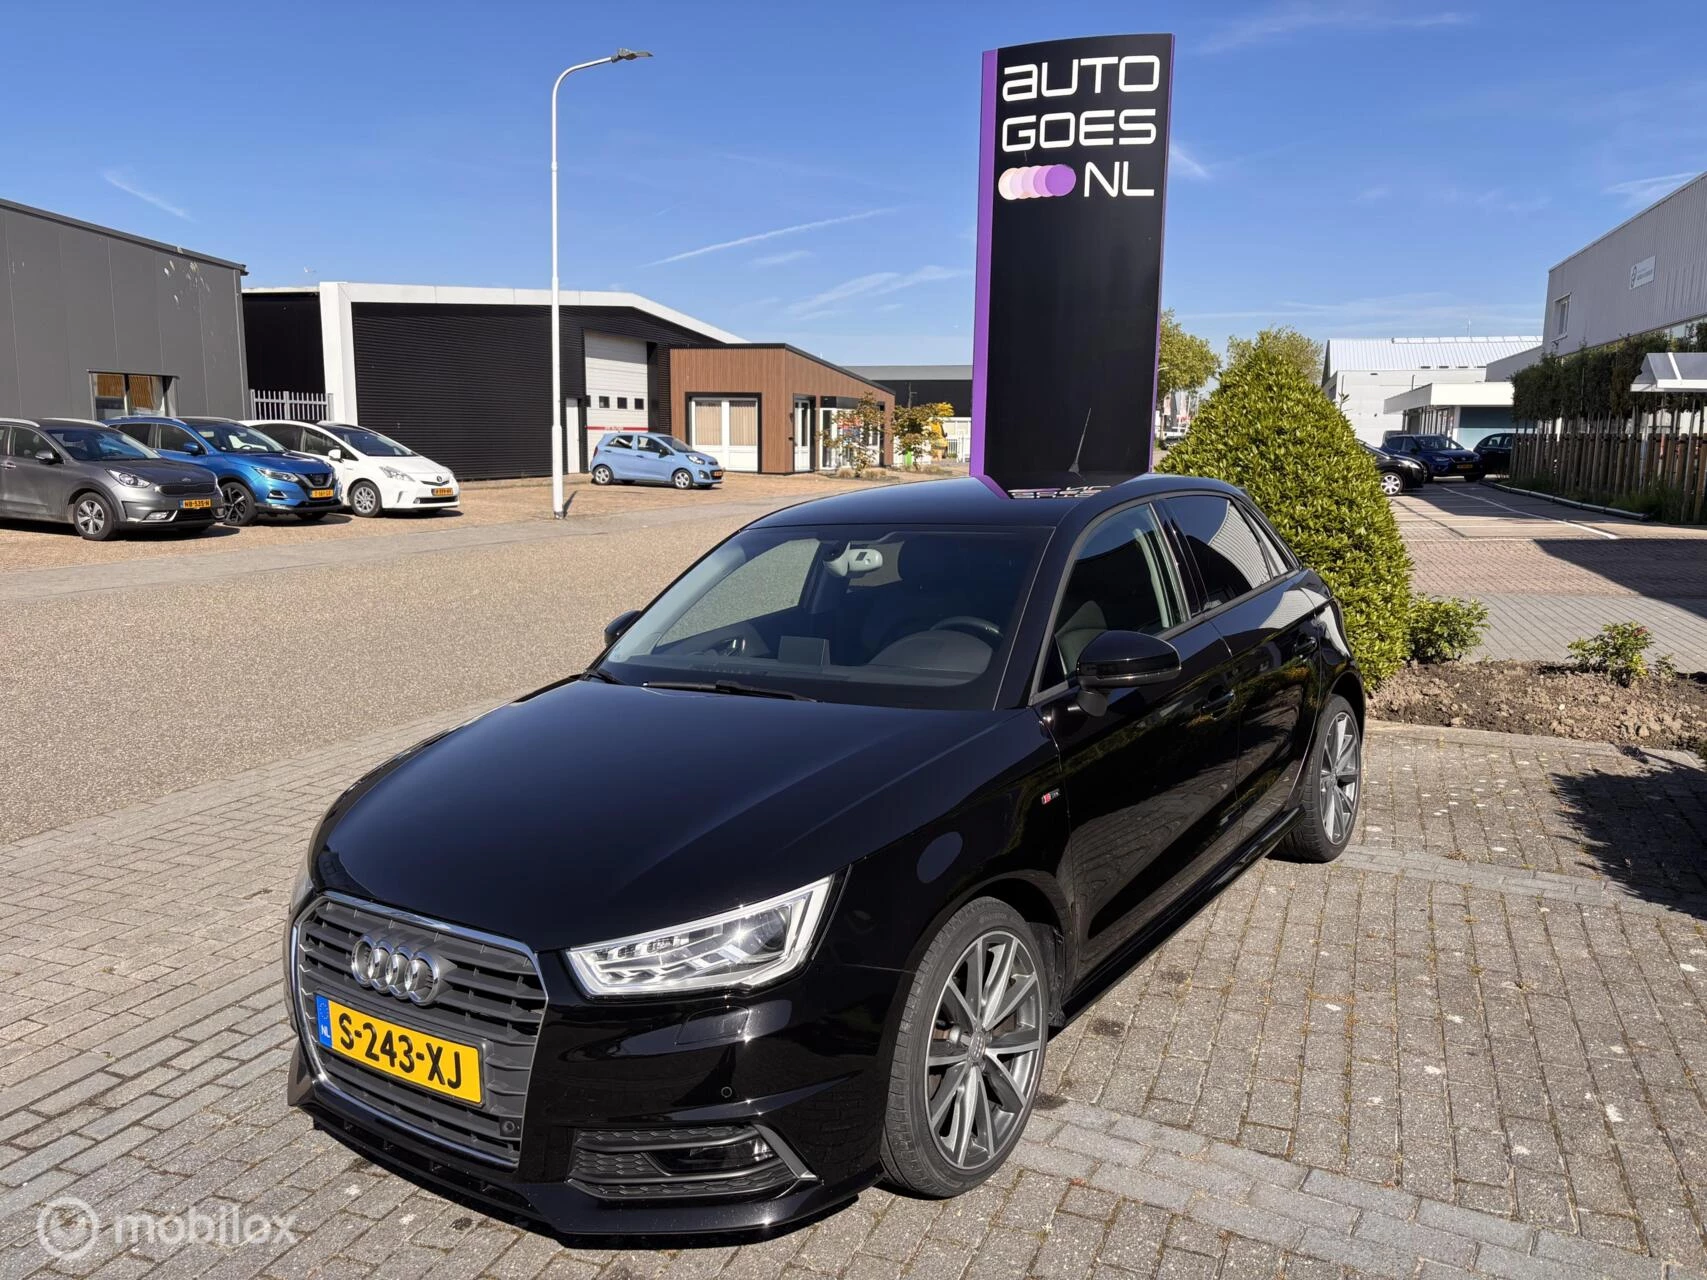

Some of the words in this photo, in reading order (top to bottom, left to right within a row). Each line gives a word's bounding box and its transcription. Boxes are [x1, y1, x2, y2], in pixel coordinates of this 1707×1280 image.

[1002, 109, 1156, 152] GOES
[1084, 161, 1154, 197] NL
[321, 1024, 330, 1038] NL
[338, 1013, 461, 1089] S-243-XJ
